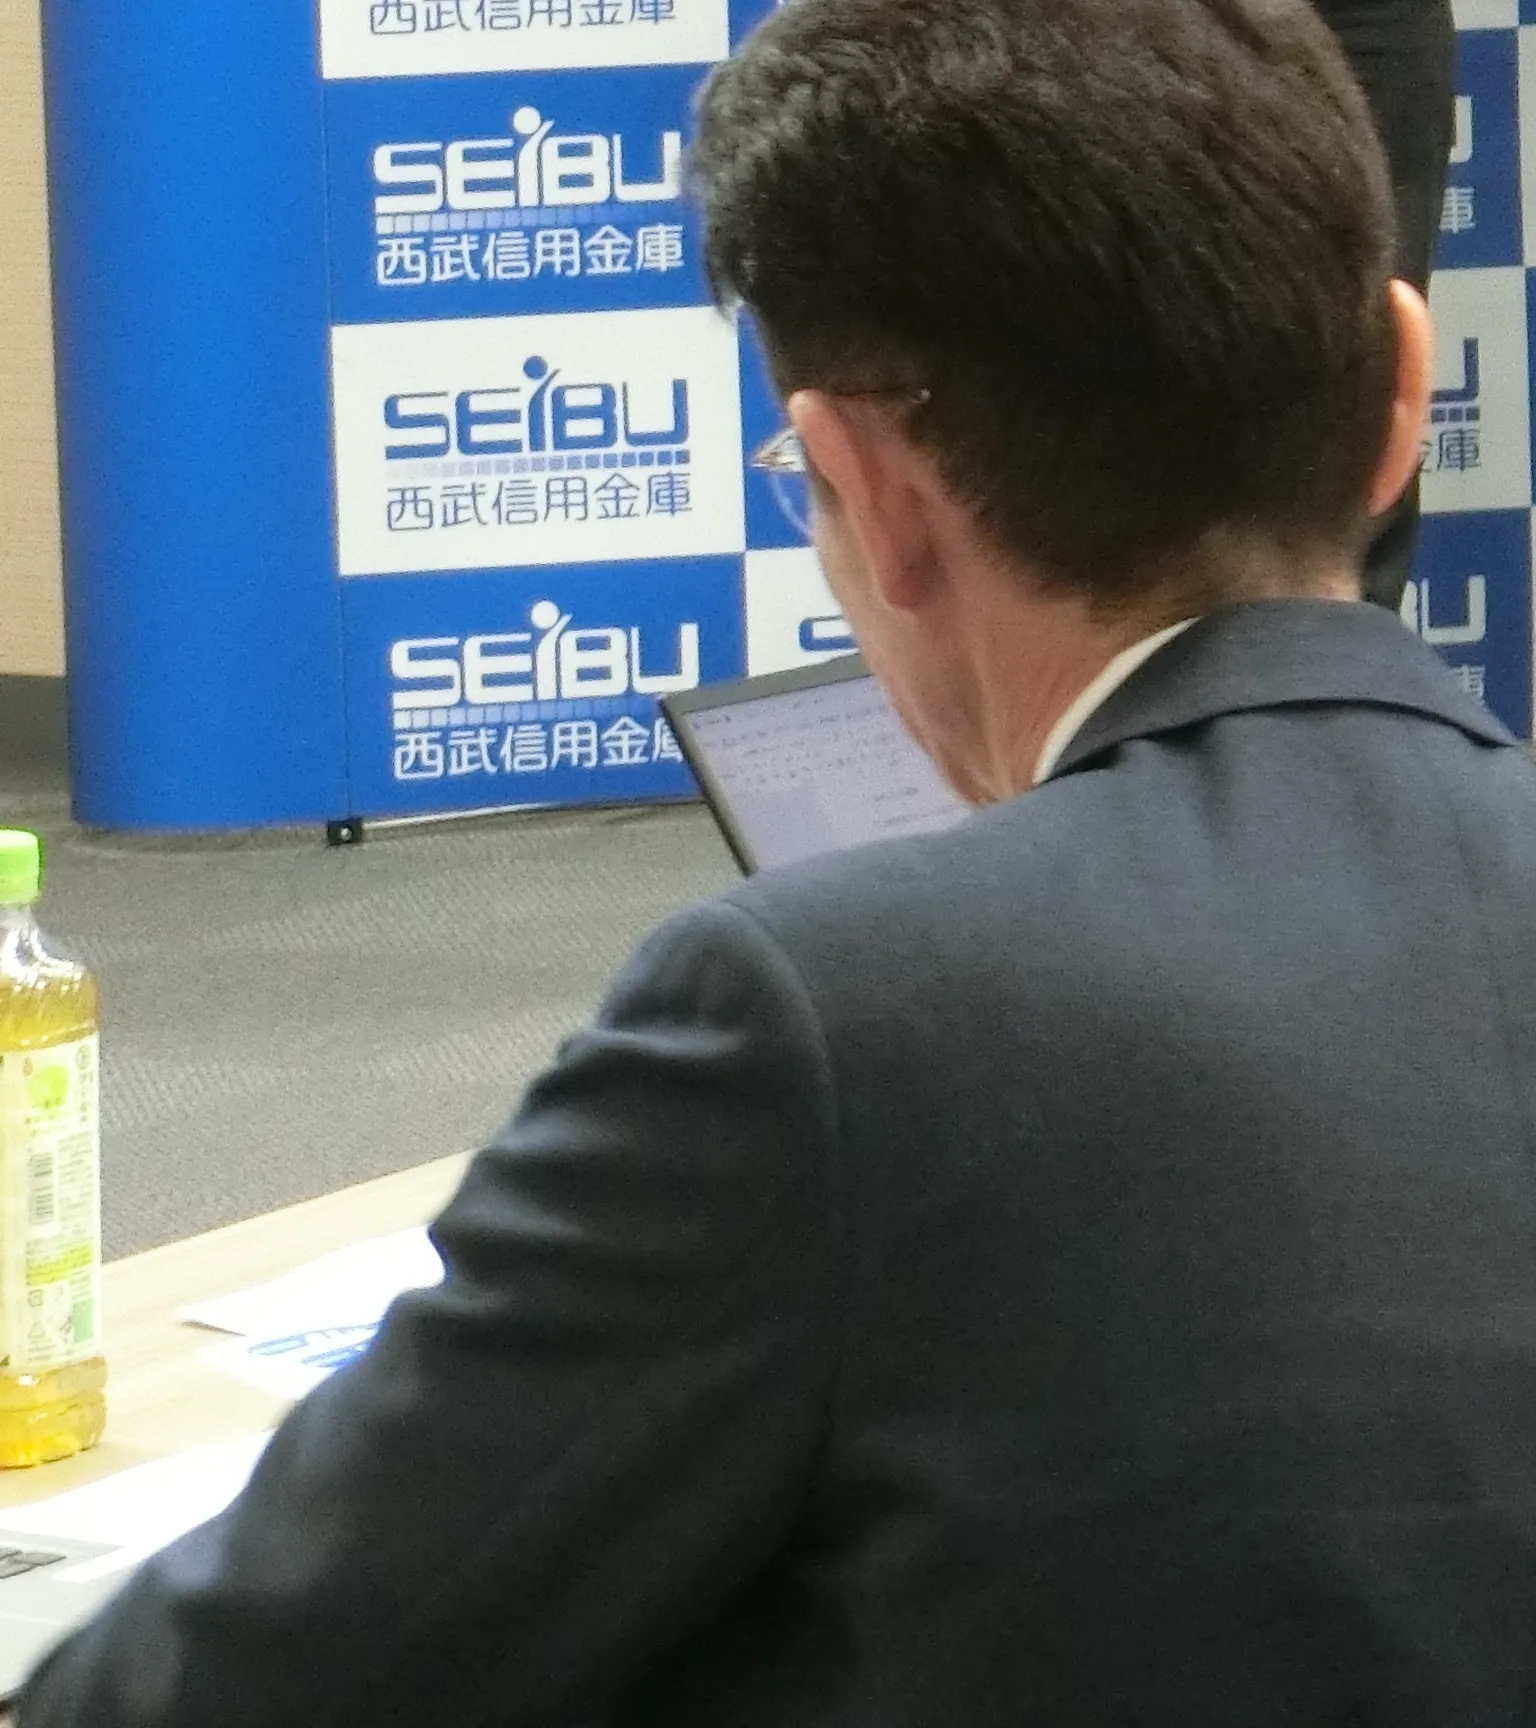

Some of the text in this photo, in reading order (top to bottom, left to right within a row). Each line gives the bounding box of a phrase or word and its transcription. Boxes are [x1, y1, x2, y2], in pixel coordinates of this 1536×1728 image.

[376, 224, 683, 285] 西武信用金庫
[387, 471, 692, 531] 西武信用金庫
